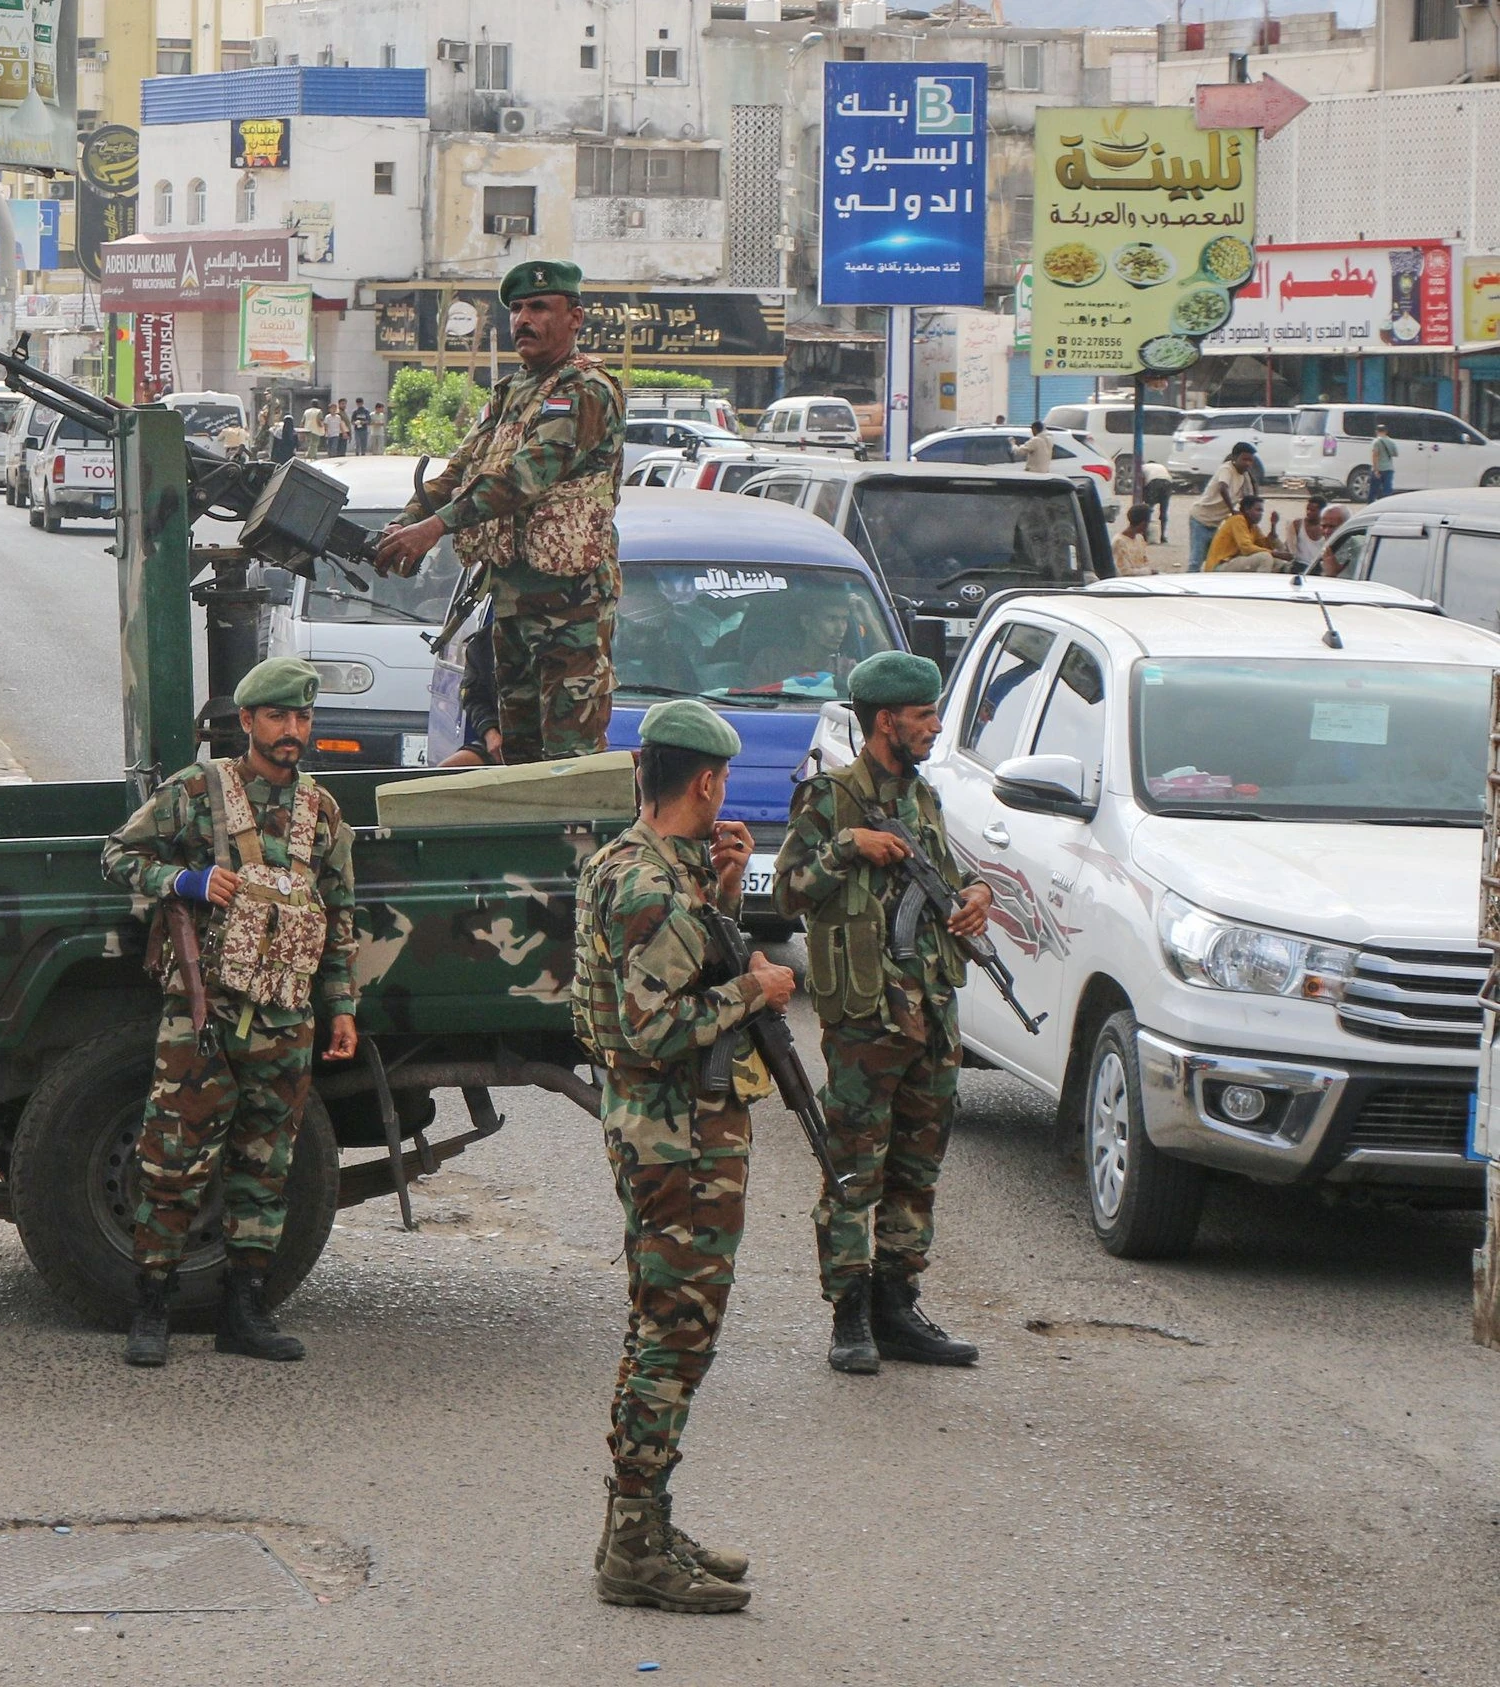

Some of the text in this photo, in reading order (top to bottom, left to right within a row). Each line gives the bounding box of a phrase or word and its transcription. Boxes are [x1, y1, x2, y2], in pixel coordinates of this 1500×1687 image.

[836, 92, 908, 124] بنك
[835, 140, 973, 175] البسيري
[1055, 130, 1242, 202] تلبينة
[834, 188, 972, 220] الدولي
[1050, 202, 1245, 229] للمعصوب والعريكة
[105, 253, 177, 274] ADEN ISLAMIC BANK
[260, 247, 282, 272] بنك
[844, 262, 875, 273] عالمية
[904, 262, 941, 274] مصرفية
[943, 262, 960, 272] ثقة
[1280, 256, 1377, 313] مطعم
[666, 304, 698, 327] نور
[1071, 337, 1122, 347] 02-278556
[1071, 350, 1123, 360] 772117523
[82, 466, 116, 478] TOY
